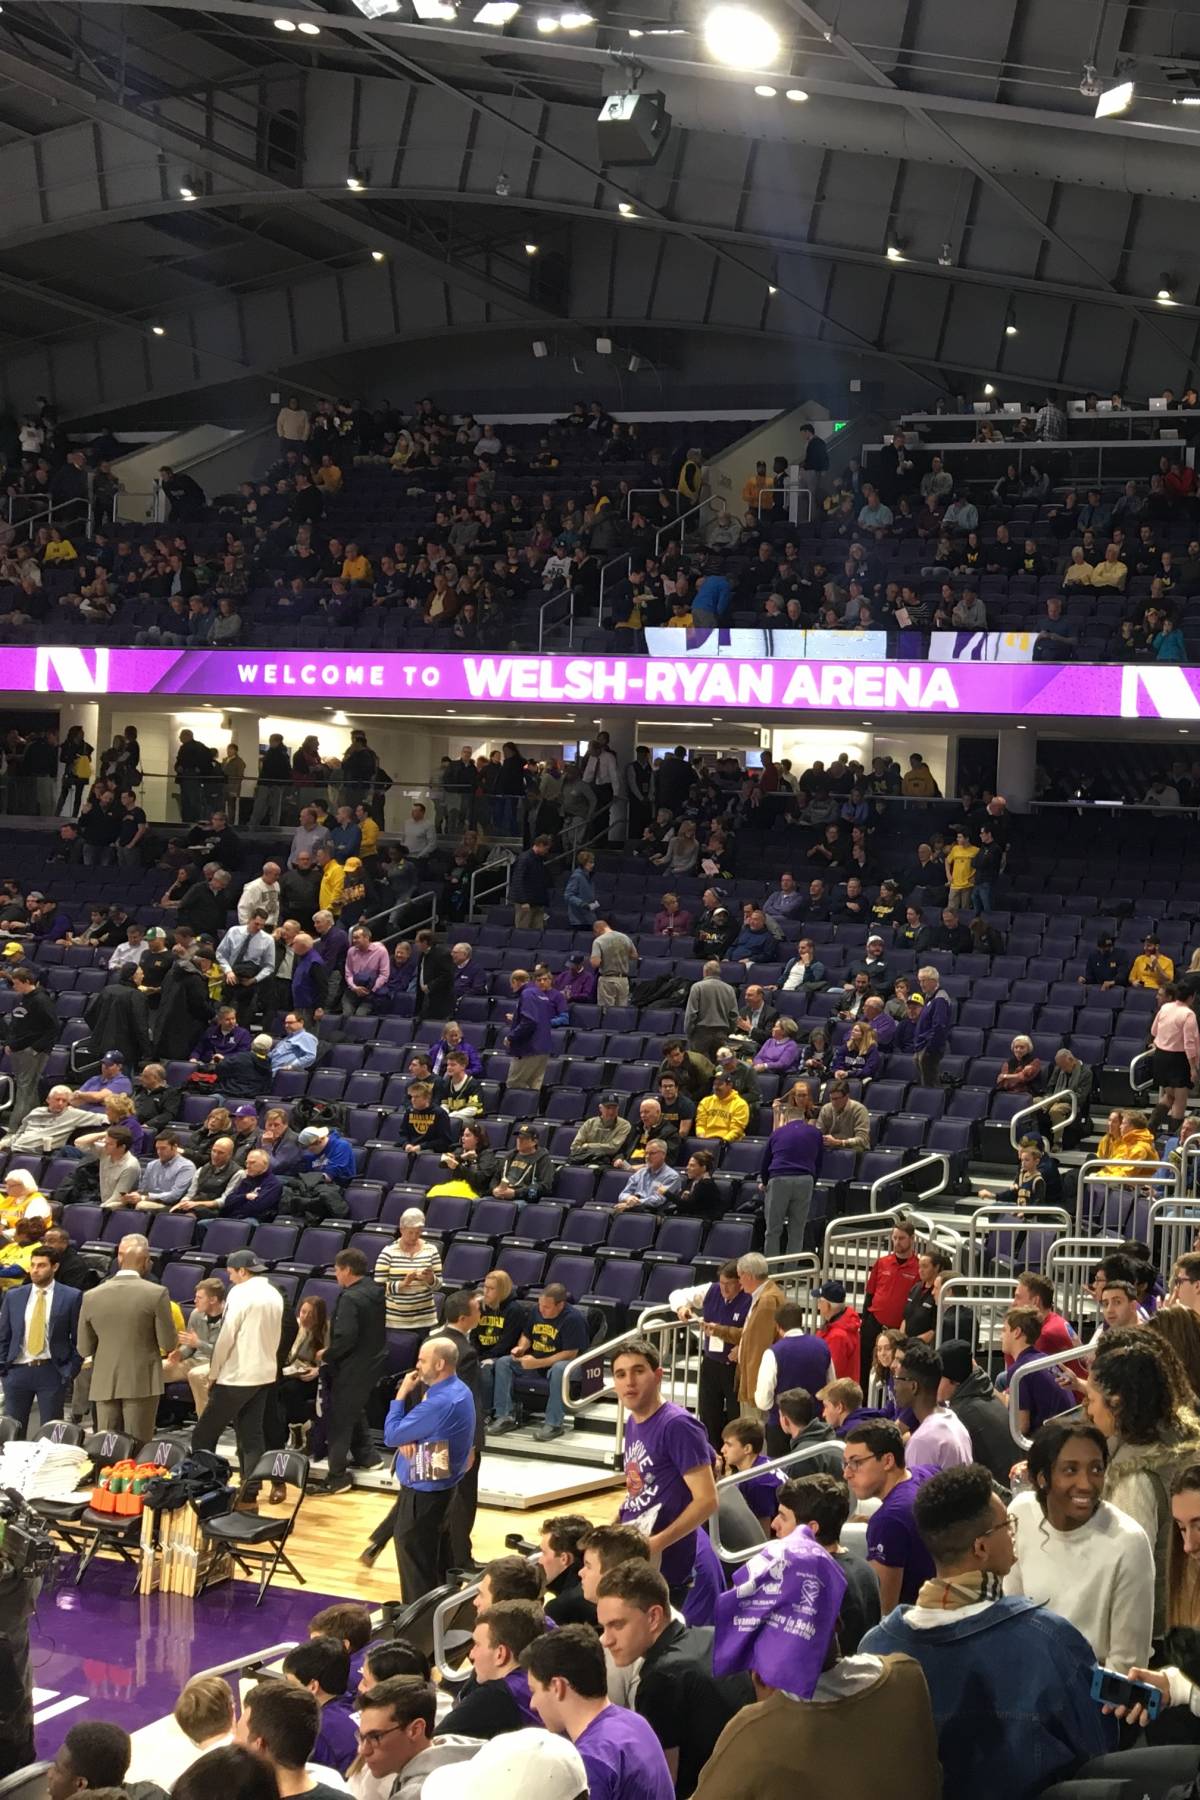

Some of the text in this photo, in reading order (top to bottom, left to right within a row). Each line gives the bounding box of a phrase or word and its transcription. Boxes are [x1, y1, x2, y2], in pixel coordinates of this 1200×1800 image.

[34, 647, 110, 693] N
[238, 658, 960, 710] WELCOME TO WELSH-RYAN ARENA
[586, 1367, 601, 1379] 110
[271, 1453, 291, 1477] N
